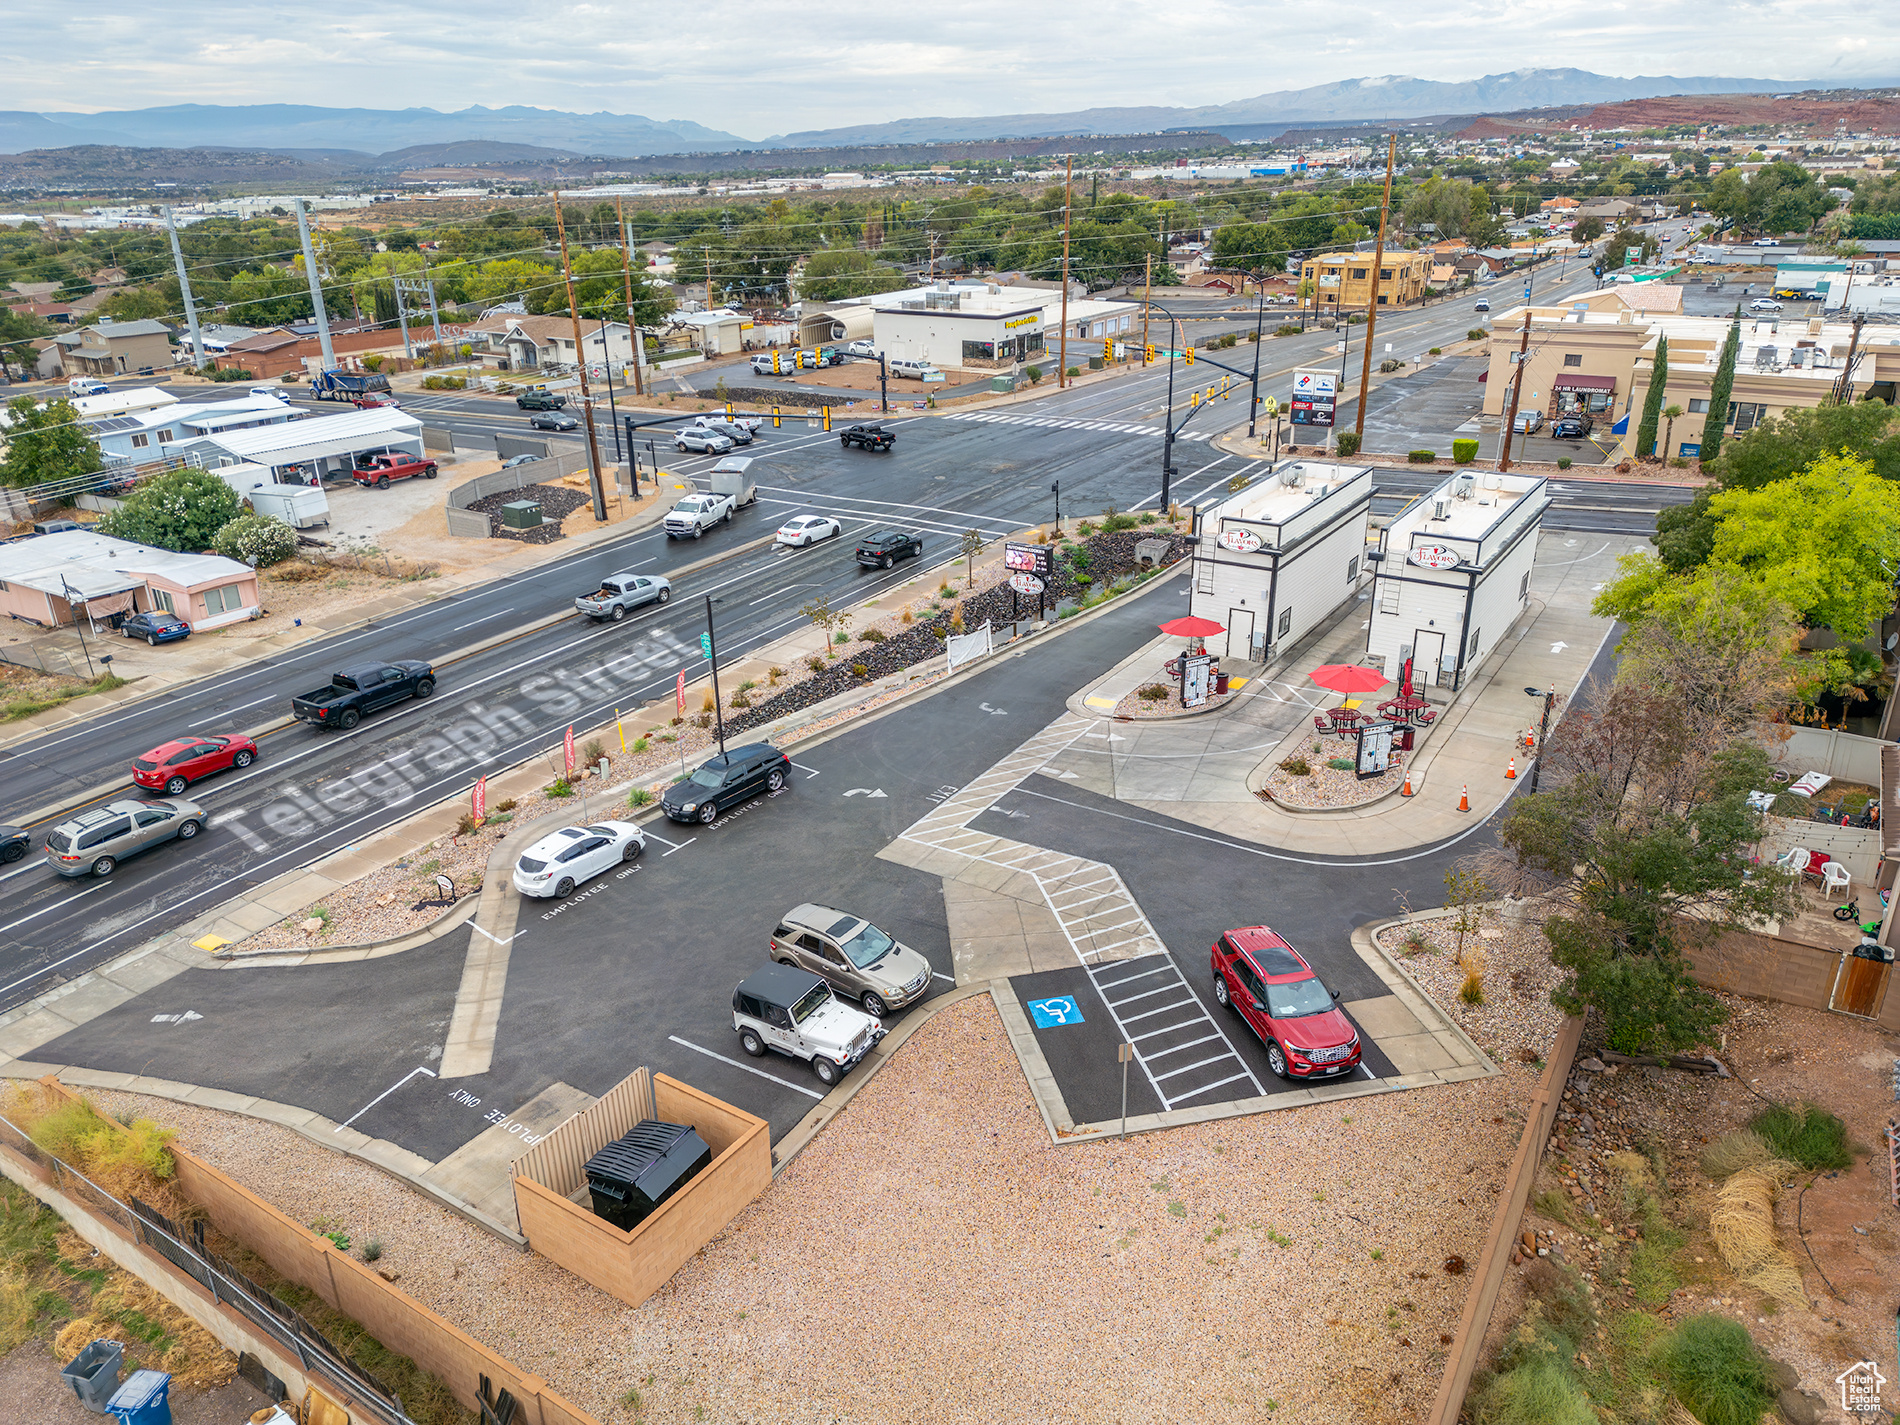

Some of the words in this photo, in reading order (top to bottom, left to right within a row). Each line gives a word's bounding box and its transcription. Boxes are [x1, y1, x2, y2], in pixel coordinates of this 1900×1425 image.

[475, 783, 484, 819] OPEN
[707, 800, 763, 830] EMPLOYEE
[541, 883, 609, 921] EMPLOYEE
[616, 863, 643, 880] ONLY
[448, 1088, 481, 1108] ONLY
